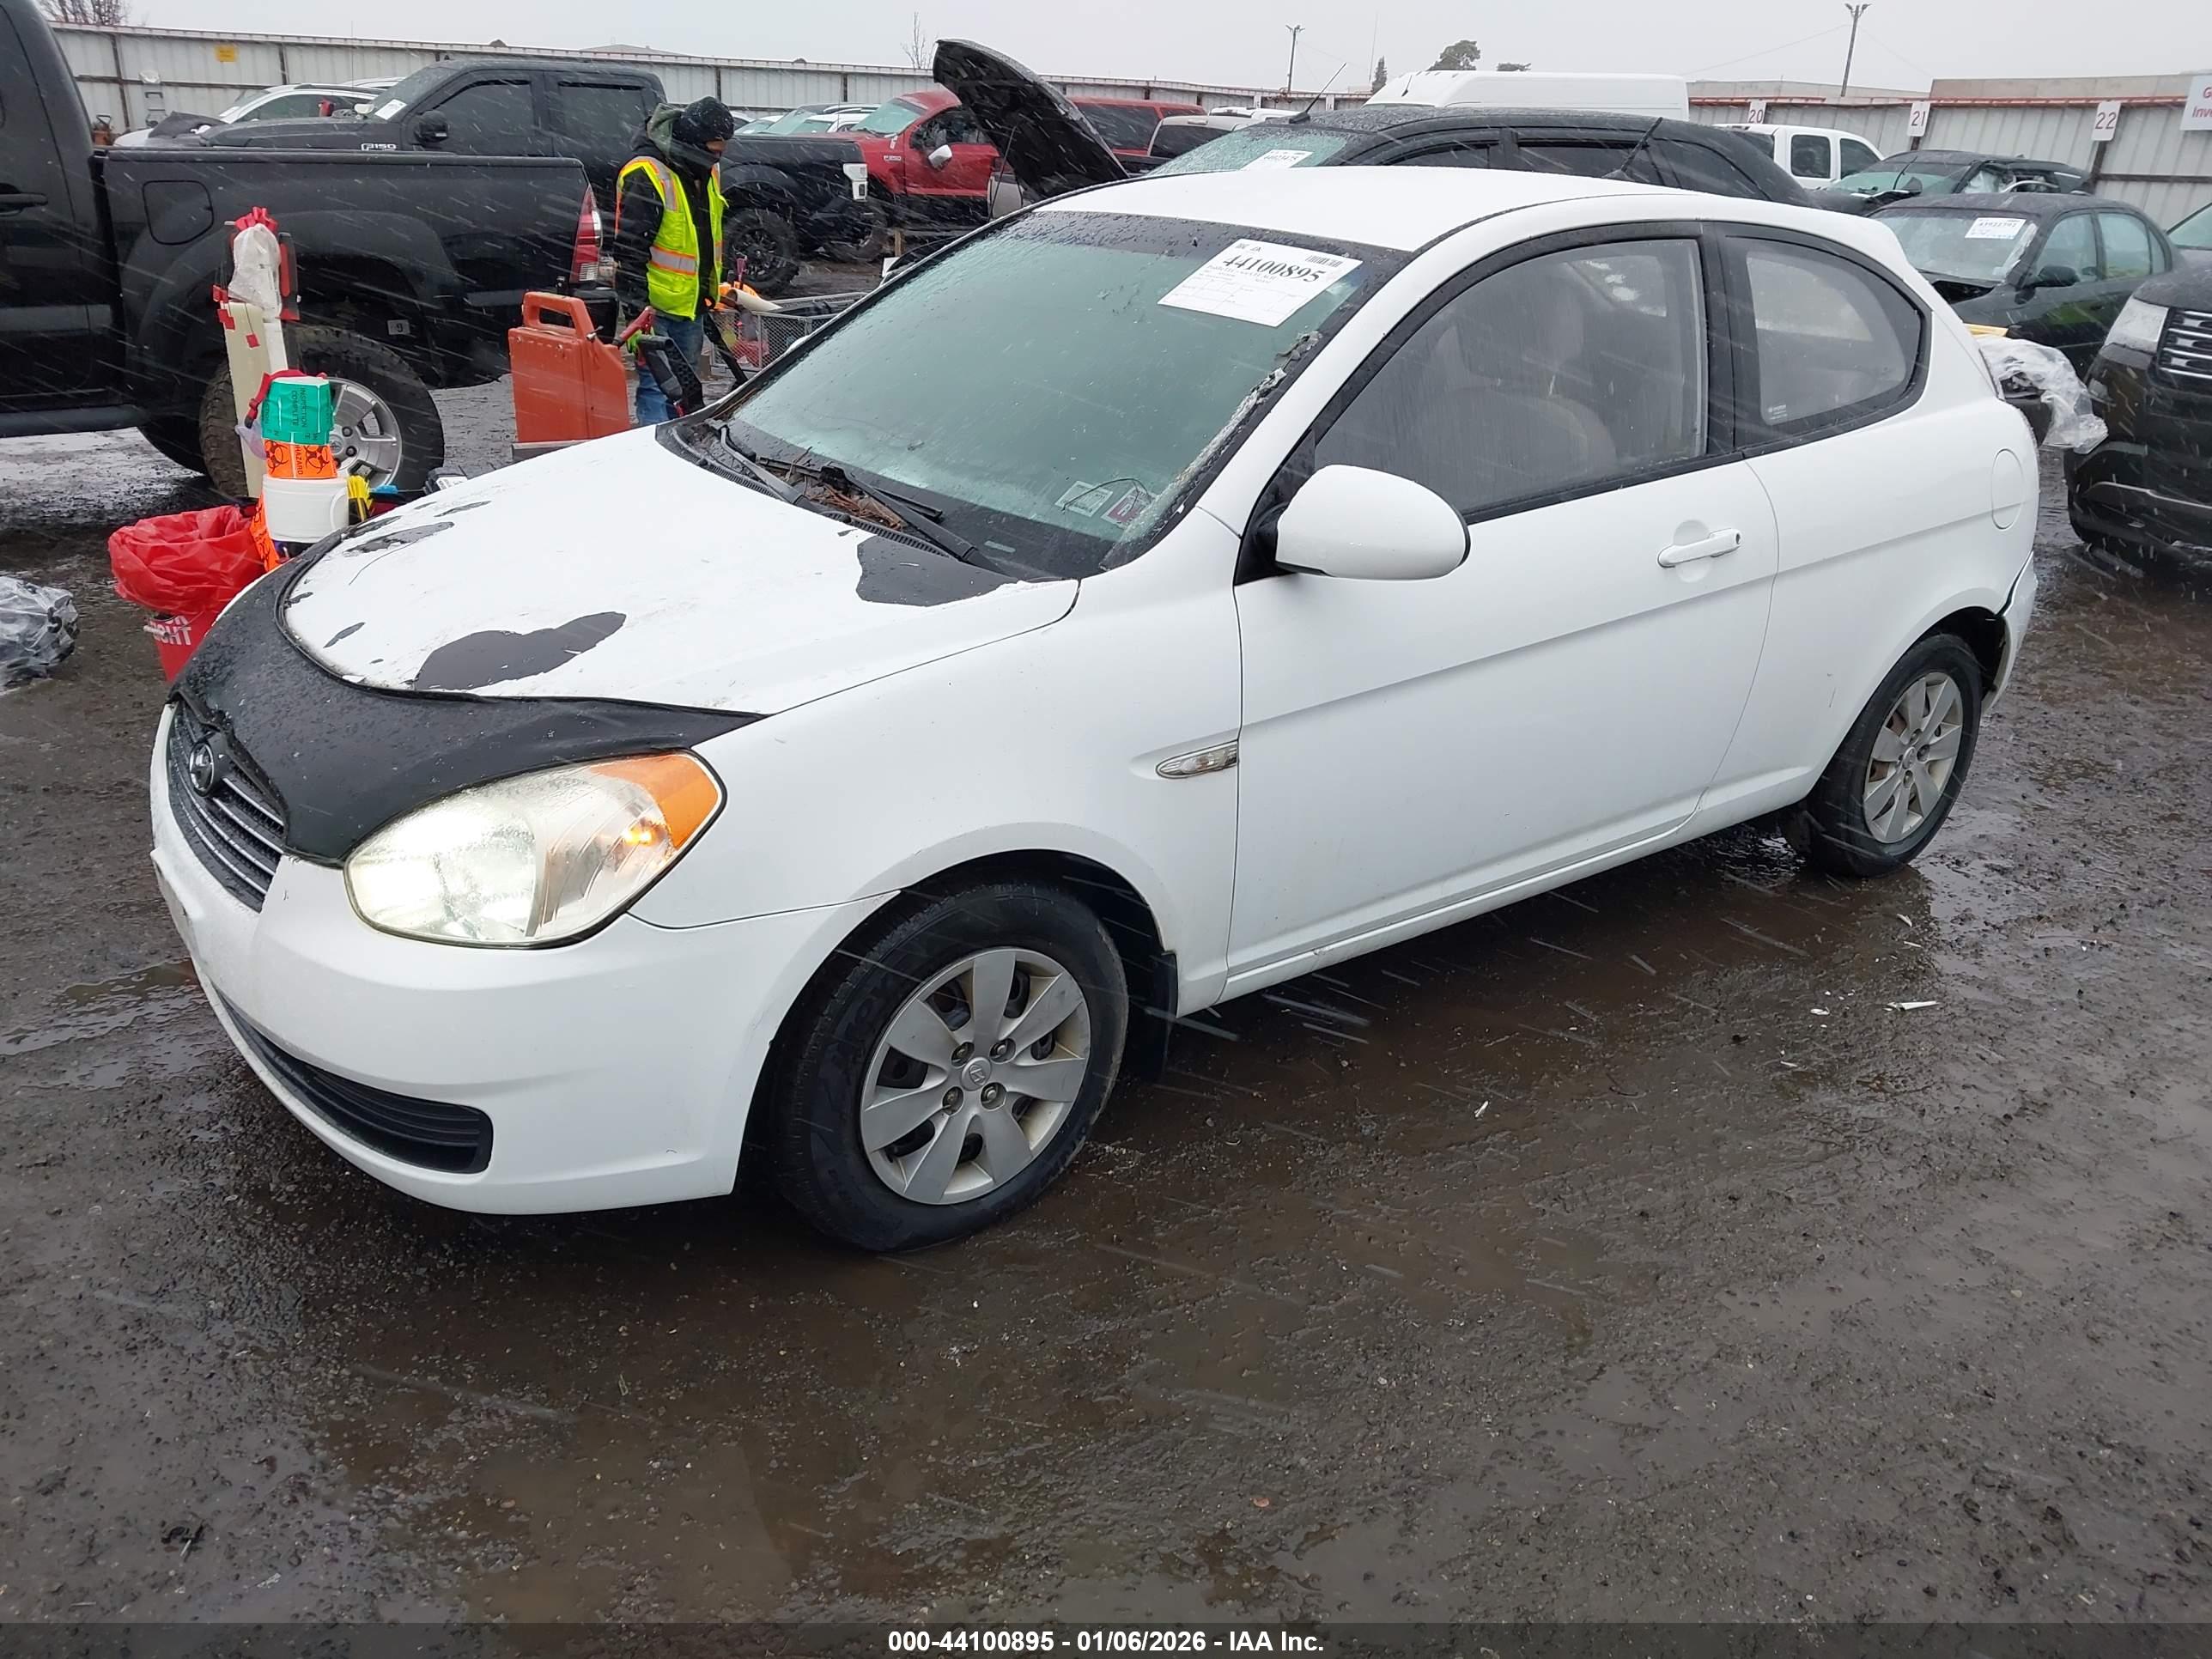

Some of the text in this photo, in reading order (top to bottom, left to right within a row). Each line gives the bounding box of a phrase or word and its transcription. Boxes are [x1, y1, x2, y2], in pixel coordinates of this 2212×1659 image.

[1748, 109, 1764, 124] 20
[1911, 110, 1926, 126] 21
[2094, 112, 2117, 130] 22
[1222, 254, 1327, 283] 44100895
